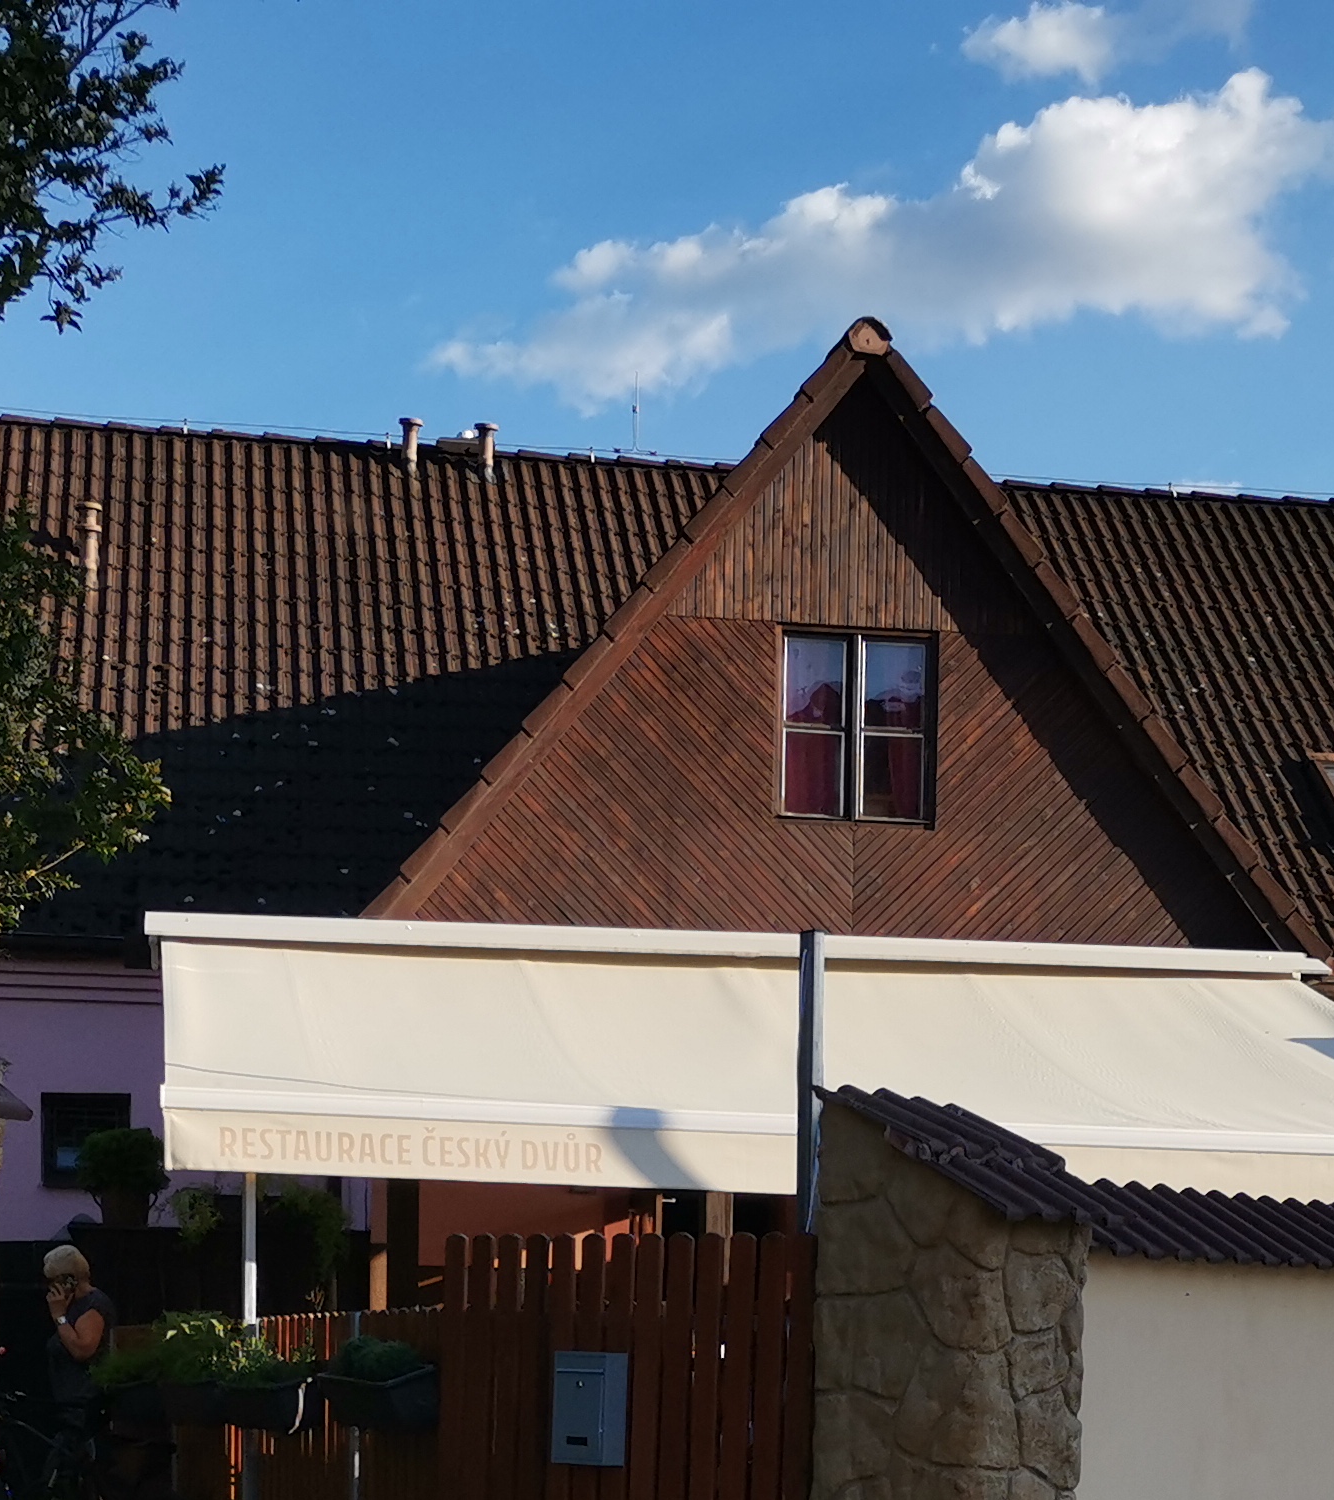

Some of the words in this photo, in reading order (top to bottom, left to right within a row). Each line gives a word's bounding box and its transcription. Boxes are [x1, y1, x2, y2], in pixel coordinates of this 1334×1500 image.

[219, 1126, 413, 1166] RESTAURACE
[422, 1126, 511, 1170] ČESKÝ
[520, 1132, 603, 1174] DVŮR
